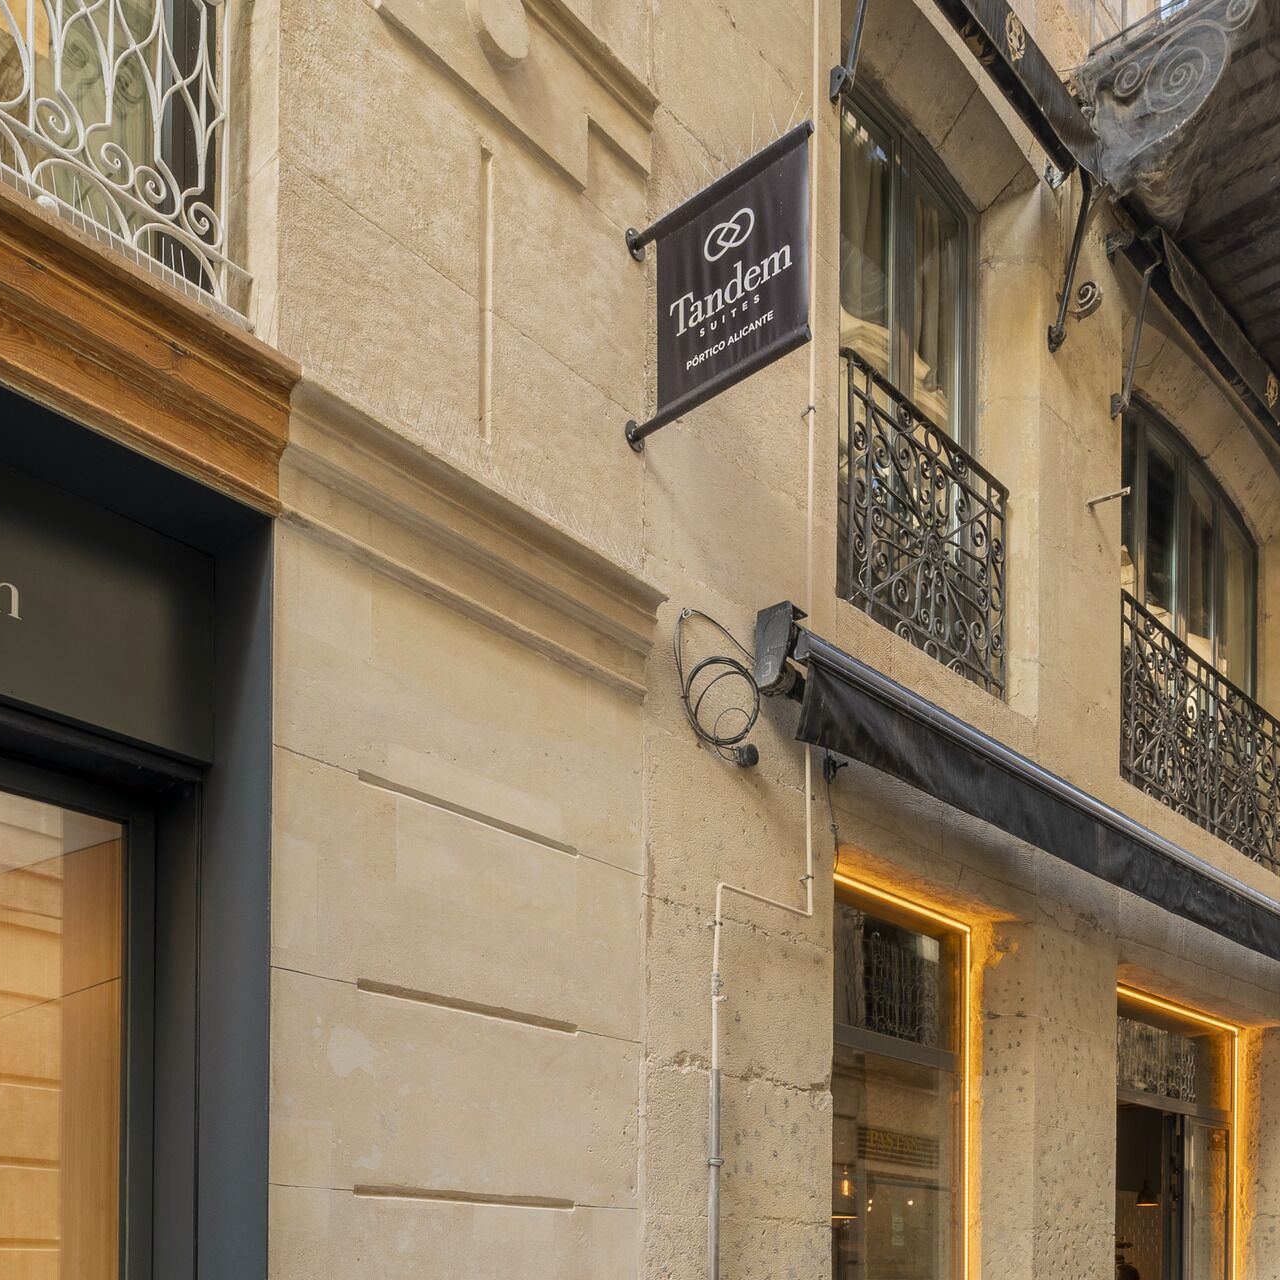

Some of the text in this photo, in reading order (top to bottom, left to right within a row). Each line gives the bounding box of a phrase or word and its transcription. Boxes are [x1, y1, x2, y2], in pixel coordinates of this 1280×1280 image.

[669, 244, 793, 337] Tandem
[699, 294, 761, 337] SUITES
[686, 310, 774, 370] PÓRTICO ALICANTE
